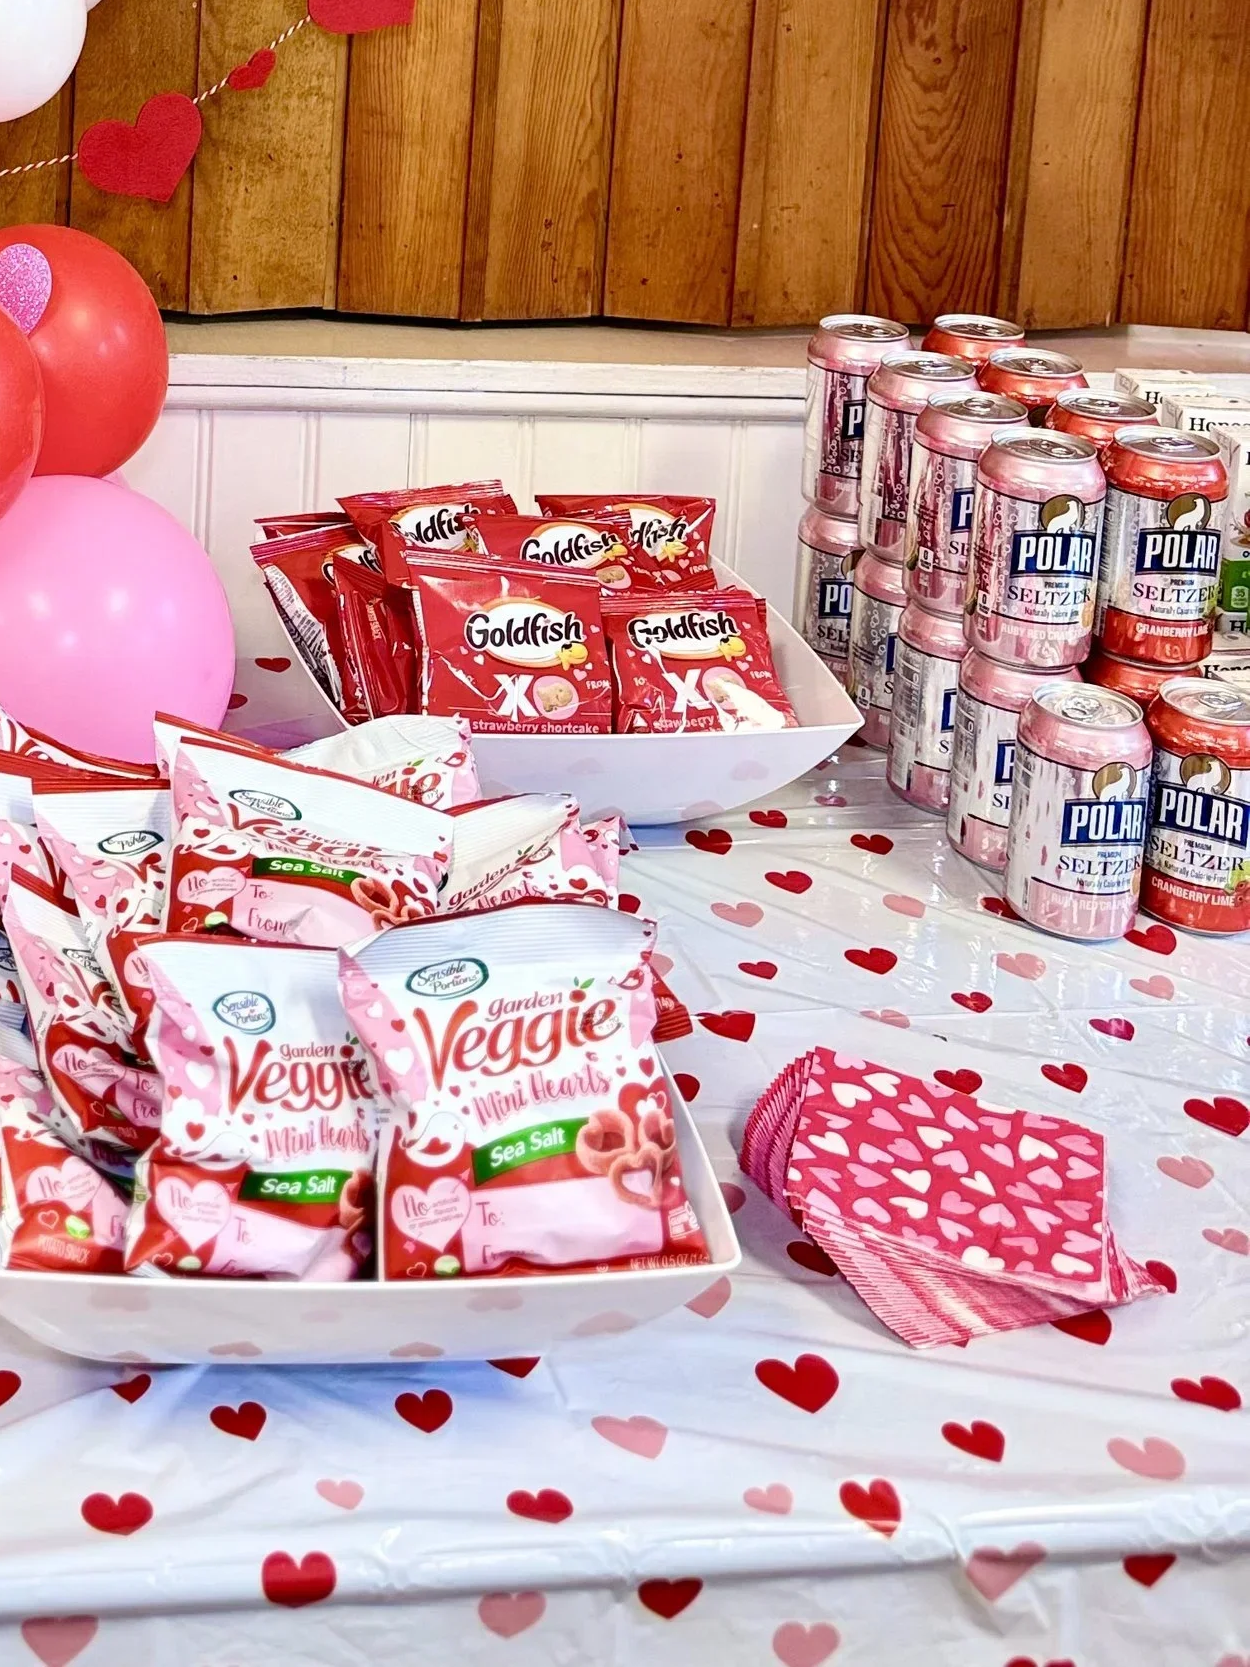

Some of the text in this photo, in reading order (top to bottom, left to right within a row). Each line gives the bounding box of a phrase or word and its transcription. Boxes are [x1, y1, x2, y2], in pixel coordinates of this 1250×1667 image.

[522, 530, 621, 567] Goldfish
[1017, 534, 1094, 573] POLAR
[1141, 533, 1218, 571] POLAR
[1007, 585, 1091, 606] SELTZER
[1133, 582, 1215, 603] SELTZER
[466, 612, 582, 649] Goldfish
[628, 612, 738, 648] Goldfish
[1136, 622, 1192, 639] CRANBERRY
[472, 718, 599, 734] strawberry shortcake
[239, 790, 284, 809] Sensible
[1068, 803, 1143, 841] POLAR
[1159, 788, 1245, 841] POLAR
[1151, 835, 1245, 871] SELTZER
[1183, 839, 1212, 851] PREMIUM
[270, 860, 345, 879] Sea Salt
[1058, 854, 1141, 876] SELTZER
[1164, 860, 1190, 878] Naturally
[449, 862, 511, 907] garden
[1152, 876, 1210, 904] CRANBERRY
[1211, 894, 1236, 907] LIME
[416, 960, 467, 986] Sensible
[429, 971, 478, 993] Portions
[221, 994, 259, 1015] Sensible
[231, 1007, 268, 1026] Portions
[487, 989, 563, 1022] garden
[280, 1042, 336, 1061] garden
[413, 996, 624, 1091] Veggie
[223, 1035, 375, 1115] Veggie
[132, 1097, 160, 1119] Fro
[470, 1065, 611, 1130] Mini Hearts
[265, 1116, 371, 1163] Mini Hearts
[489, 1127, 566, 1169] Sea Salt
[260, 1175, 337, 1195] Sea Salt
[403, 1193, 430, 1218] No
